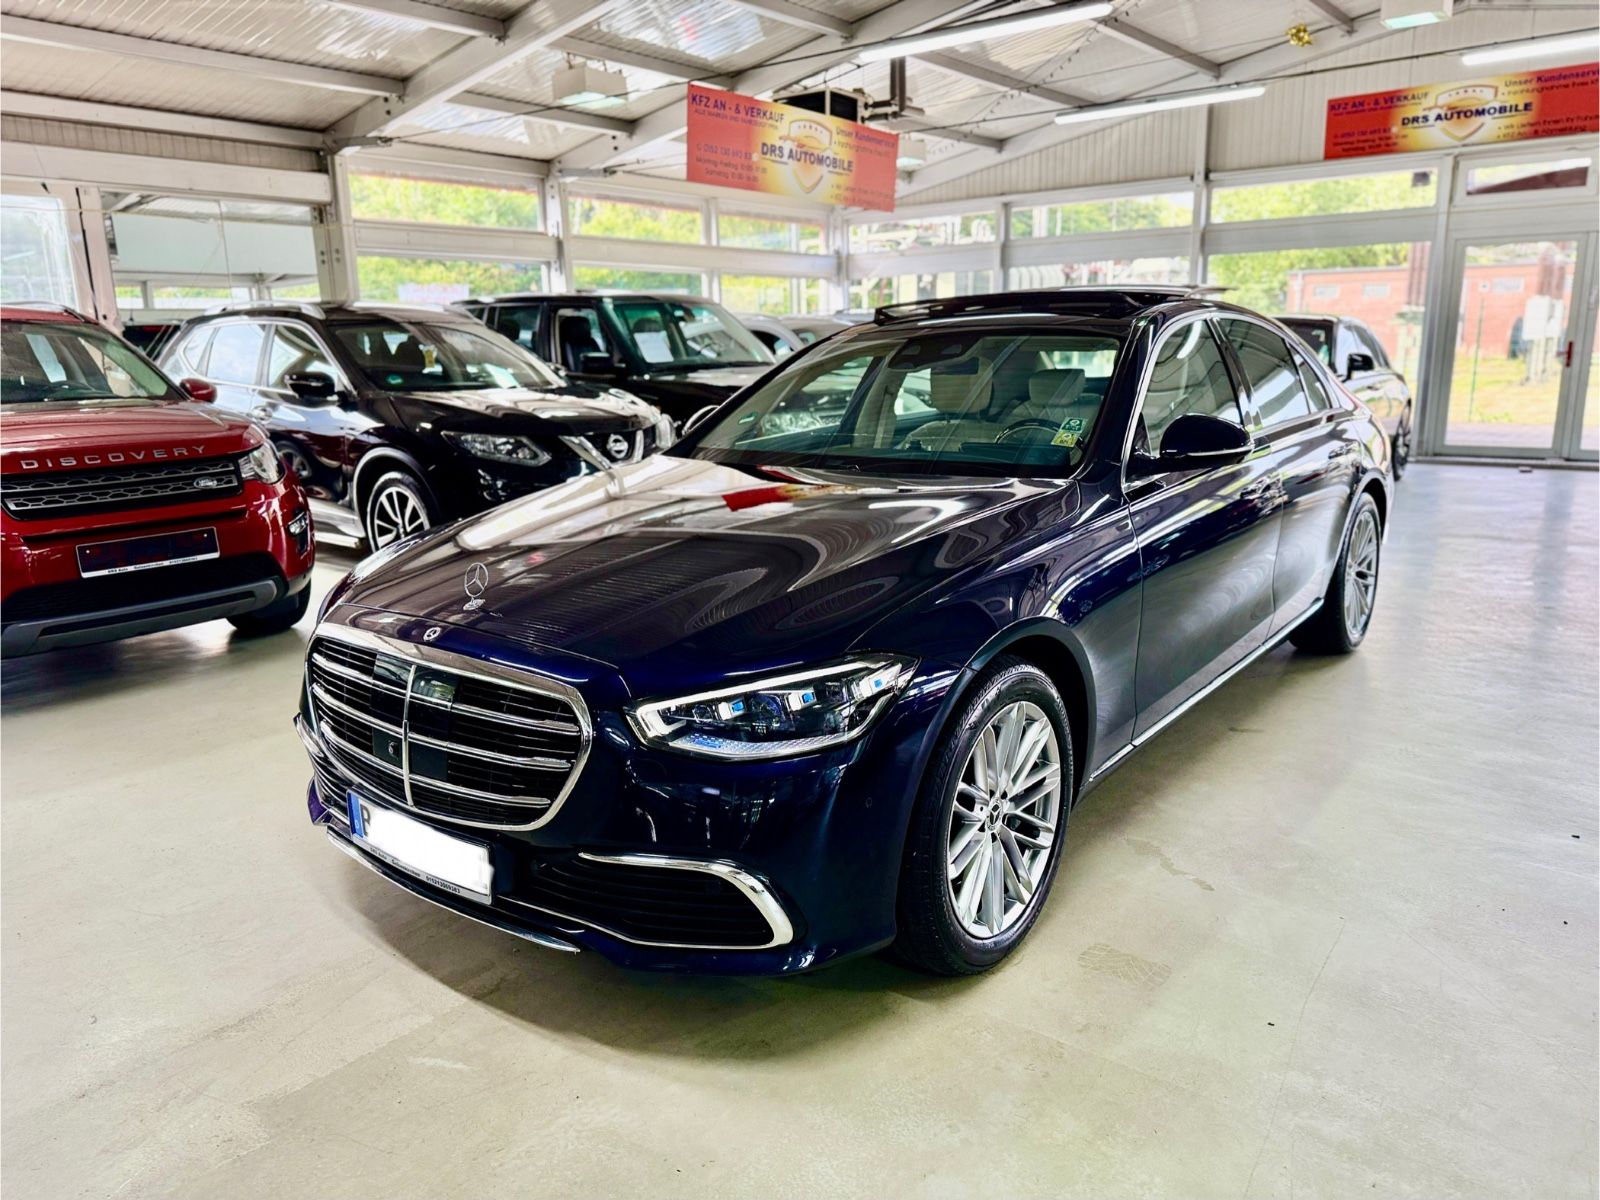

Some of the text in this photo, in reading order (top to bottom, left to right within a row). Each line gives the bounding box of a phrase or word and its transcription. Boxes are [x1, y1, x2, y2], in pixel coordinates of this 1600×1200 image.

[691, 93, 710, 109] KFZ
[713, 98, 726, 112] AN
[735, 103, 741, 114] &
[744, 105, 784, 123] VERKAUF
[1330, 102, 1349, 111] KFZ
[1351, 100, 1365, 109] AN
[1373, 98, 1380, 106] &
[1383, 91, 1428, 105] VERKAUF
[1401, 114, 1430, 126] DRS
[1434, 102, 1533, 122] AUTOMOBILE
[761, 142, 784, 159] DRS
[787, 148, 854, 173] AUTOMOBILE
[20, 445, 206, 470] DISCOVERY
